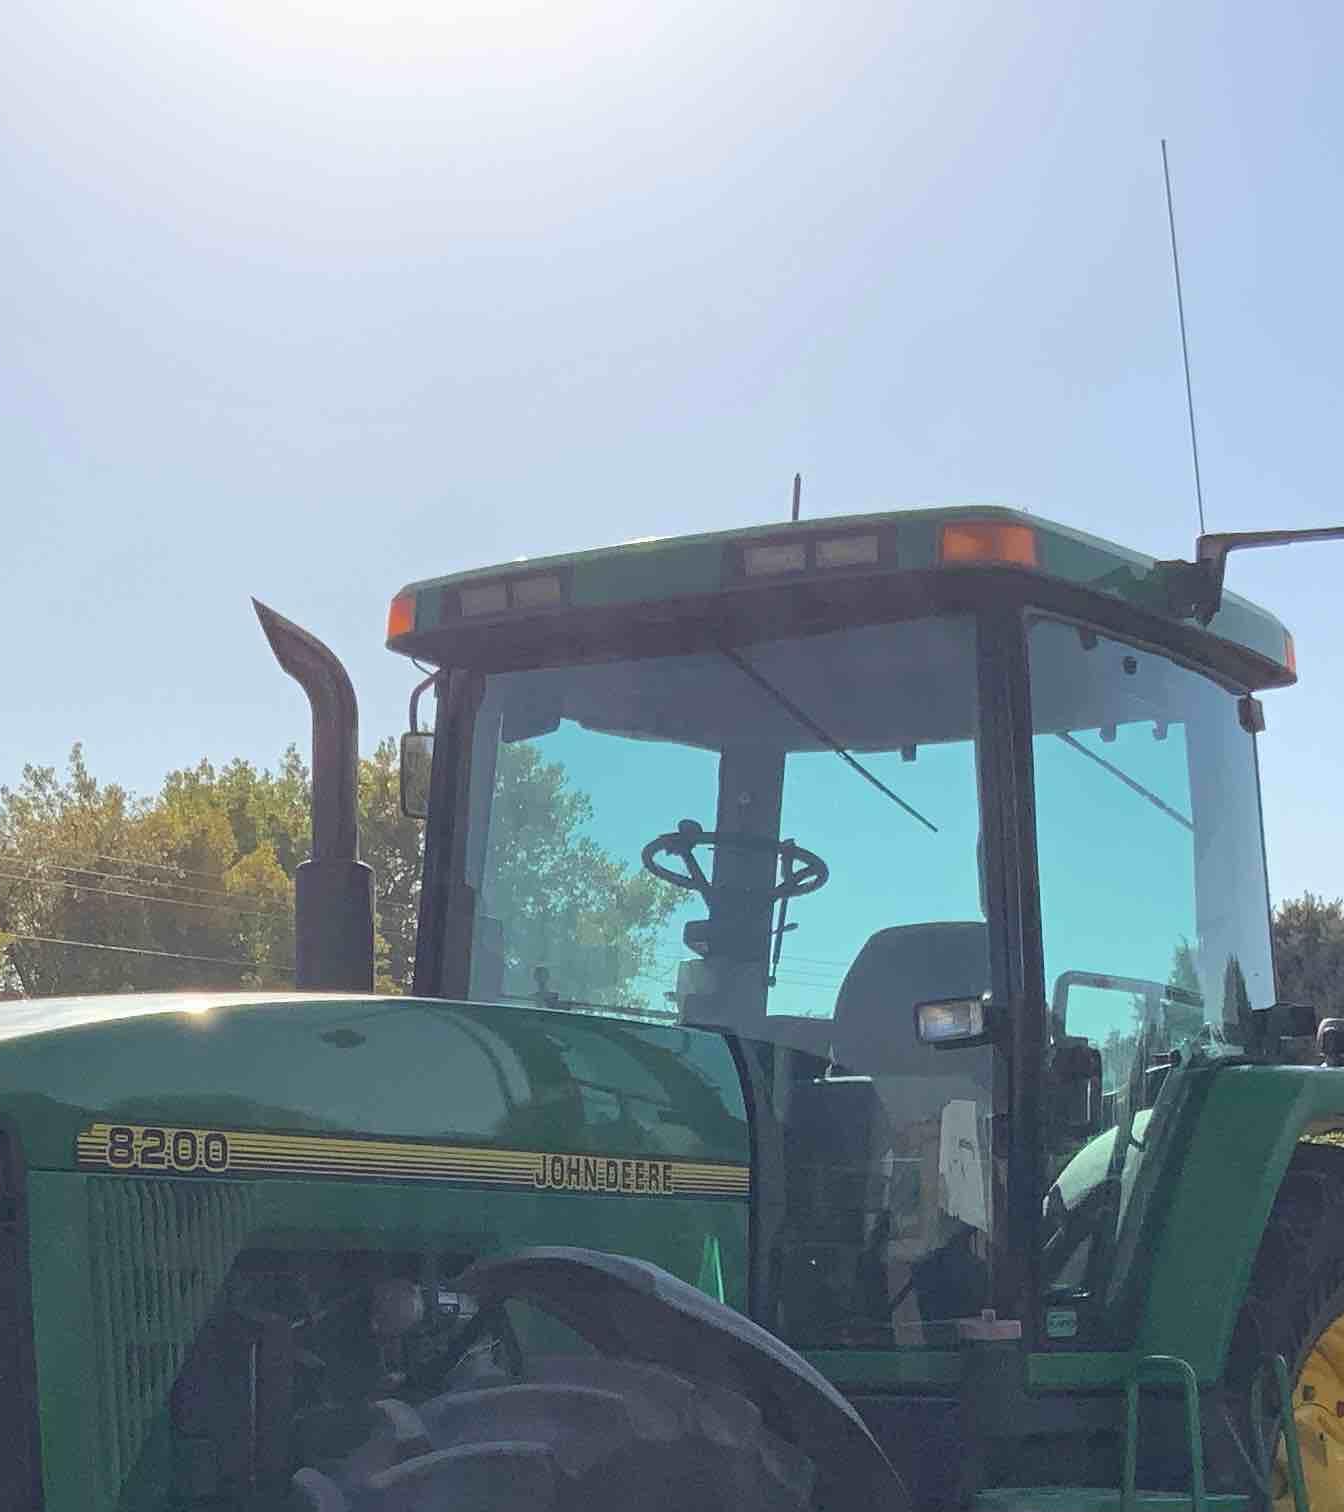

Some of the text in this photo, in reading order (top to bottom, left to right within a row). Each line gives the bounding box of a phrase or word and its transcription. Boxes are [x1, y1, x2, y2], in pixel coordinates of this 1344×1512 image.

[108, 1126, 229, 1171] 8200
[534, 1154, 674, 1194] JOHN DEERE
